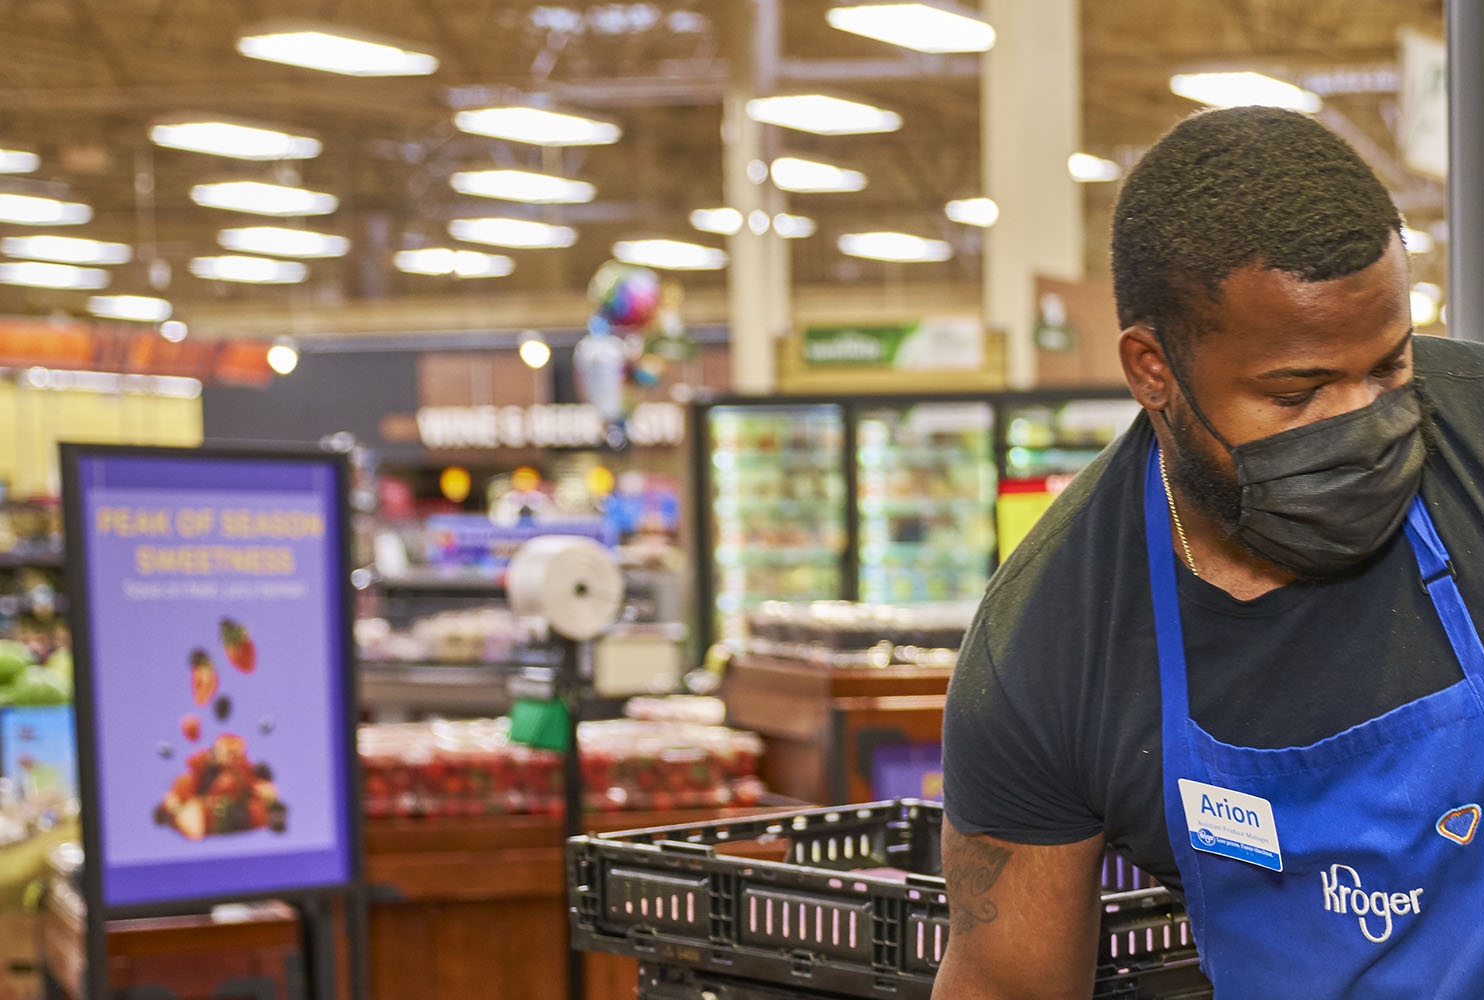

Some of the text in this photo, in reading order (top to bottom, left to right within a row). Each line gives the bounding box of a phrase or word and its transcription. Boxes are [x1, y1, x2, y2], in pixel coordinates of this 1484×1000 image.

[96, 507, 326, 540] PEAK OF SEASON
[135, 545, 294, 575] SWEETNESS
[1201, 793, 1260, 828] Arion
[1320, 863, 1424, 944] Kroger
